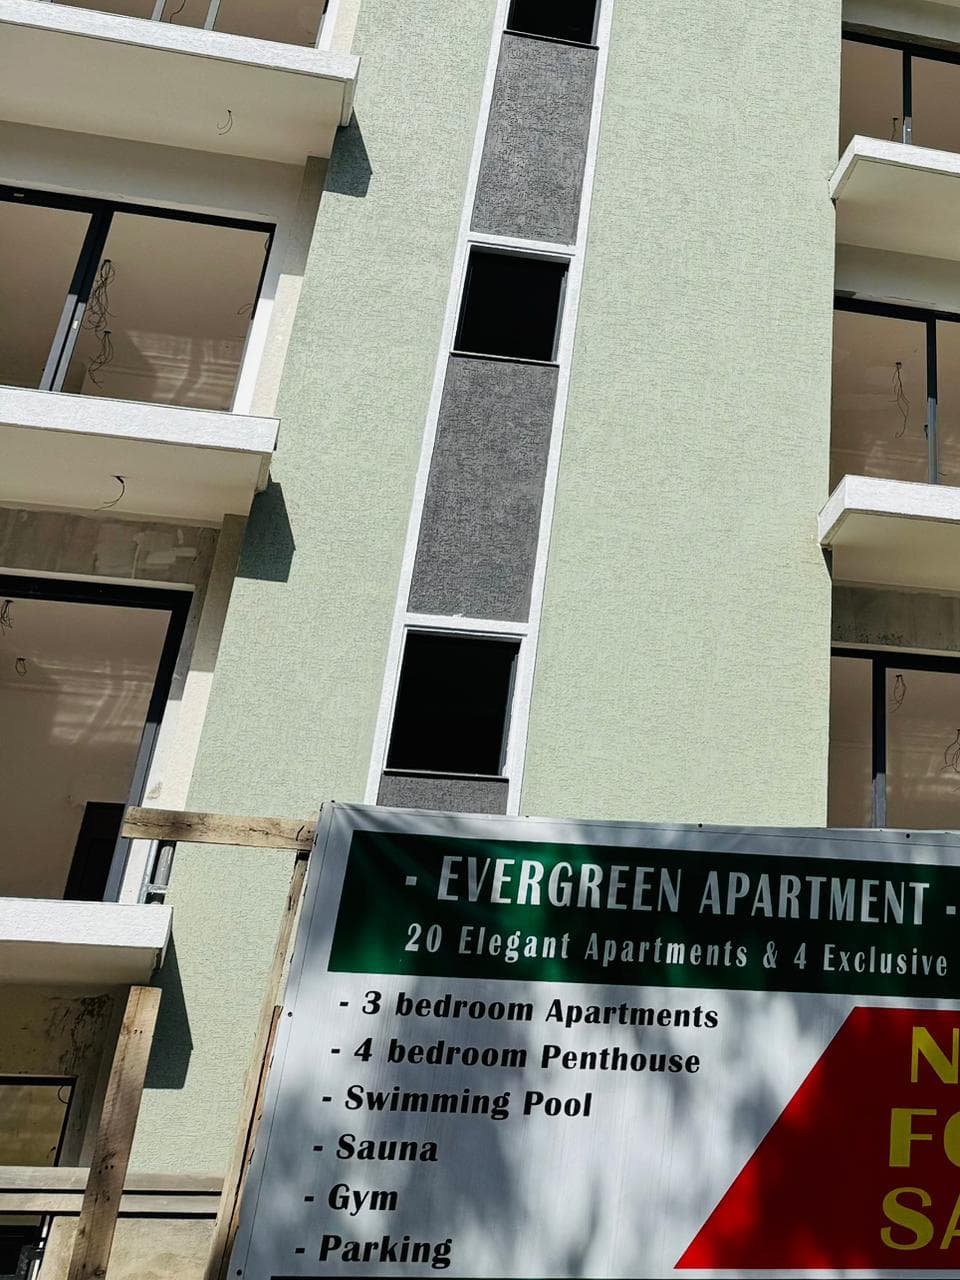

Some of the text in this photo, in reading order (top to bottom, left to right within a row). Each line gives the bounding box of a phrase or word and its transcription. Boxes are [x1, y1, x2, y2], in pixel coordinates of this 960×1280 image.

[437, 855, 682, 914] EVERGREEN
[699, 870, 930, 925] APARTMENT
[404, 923, 442, 953] 20
[458, 926, 571, 963] Elegant
[584, 932, 748, 968] Apartments
[763, 941, 778, 969] &
[794, 943, 807, 969] 4
[823, 944, 948, 977] Exclusive
[361, 990, 382, 1015] 3
[395, 992, 534, 1021] bedroom
[545, 998, 719, 1029] Apartments
[354, 1038, 372, 1062] 4
[388, 1038, 527, 1068] bedroom
[540, 1044, 700, 1074] Penthouse
[344, 1084, 511, 1120] Swimming
[522, 1090, 592, 1117] Pool
[336, 1134, 438, 1162] Sauna
[328, 1183, 398, 1217] Gym
[318, 1234, 453, 1269] Parking
